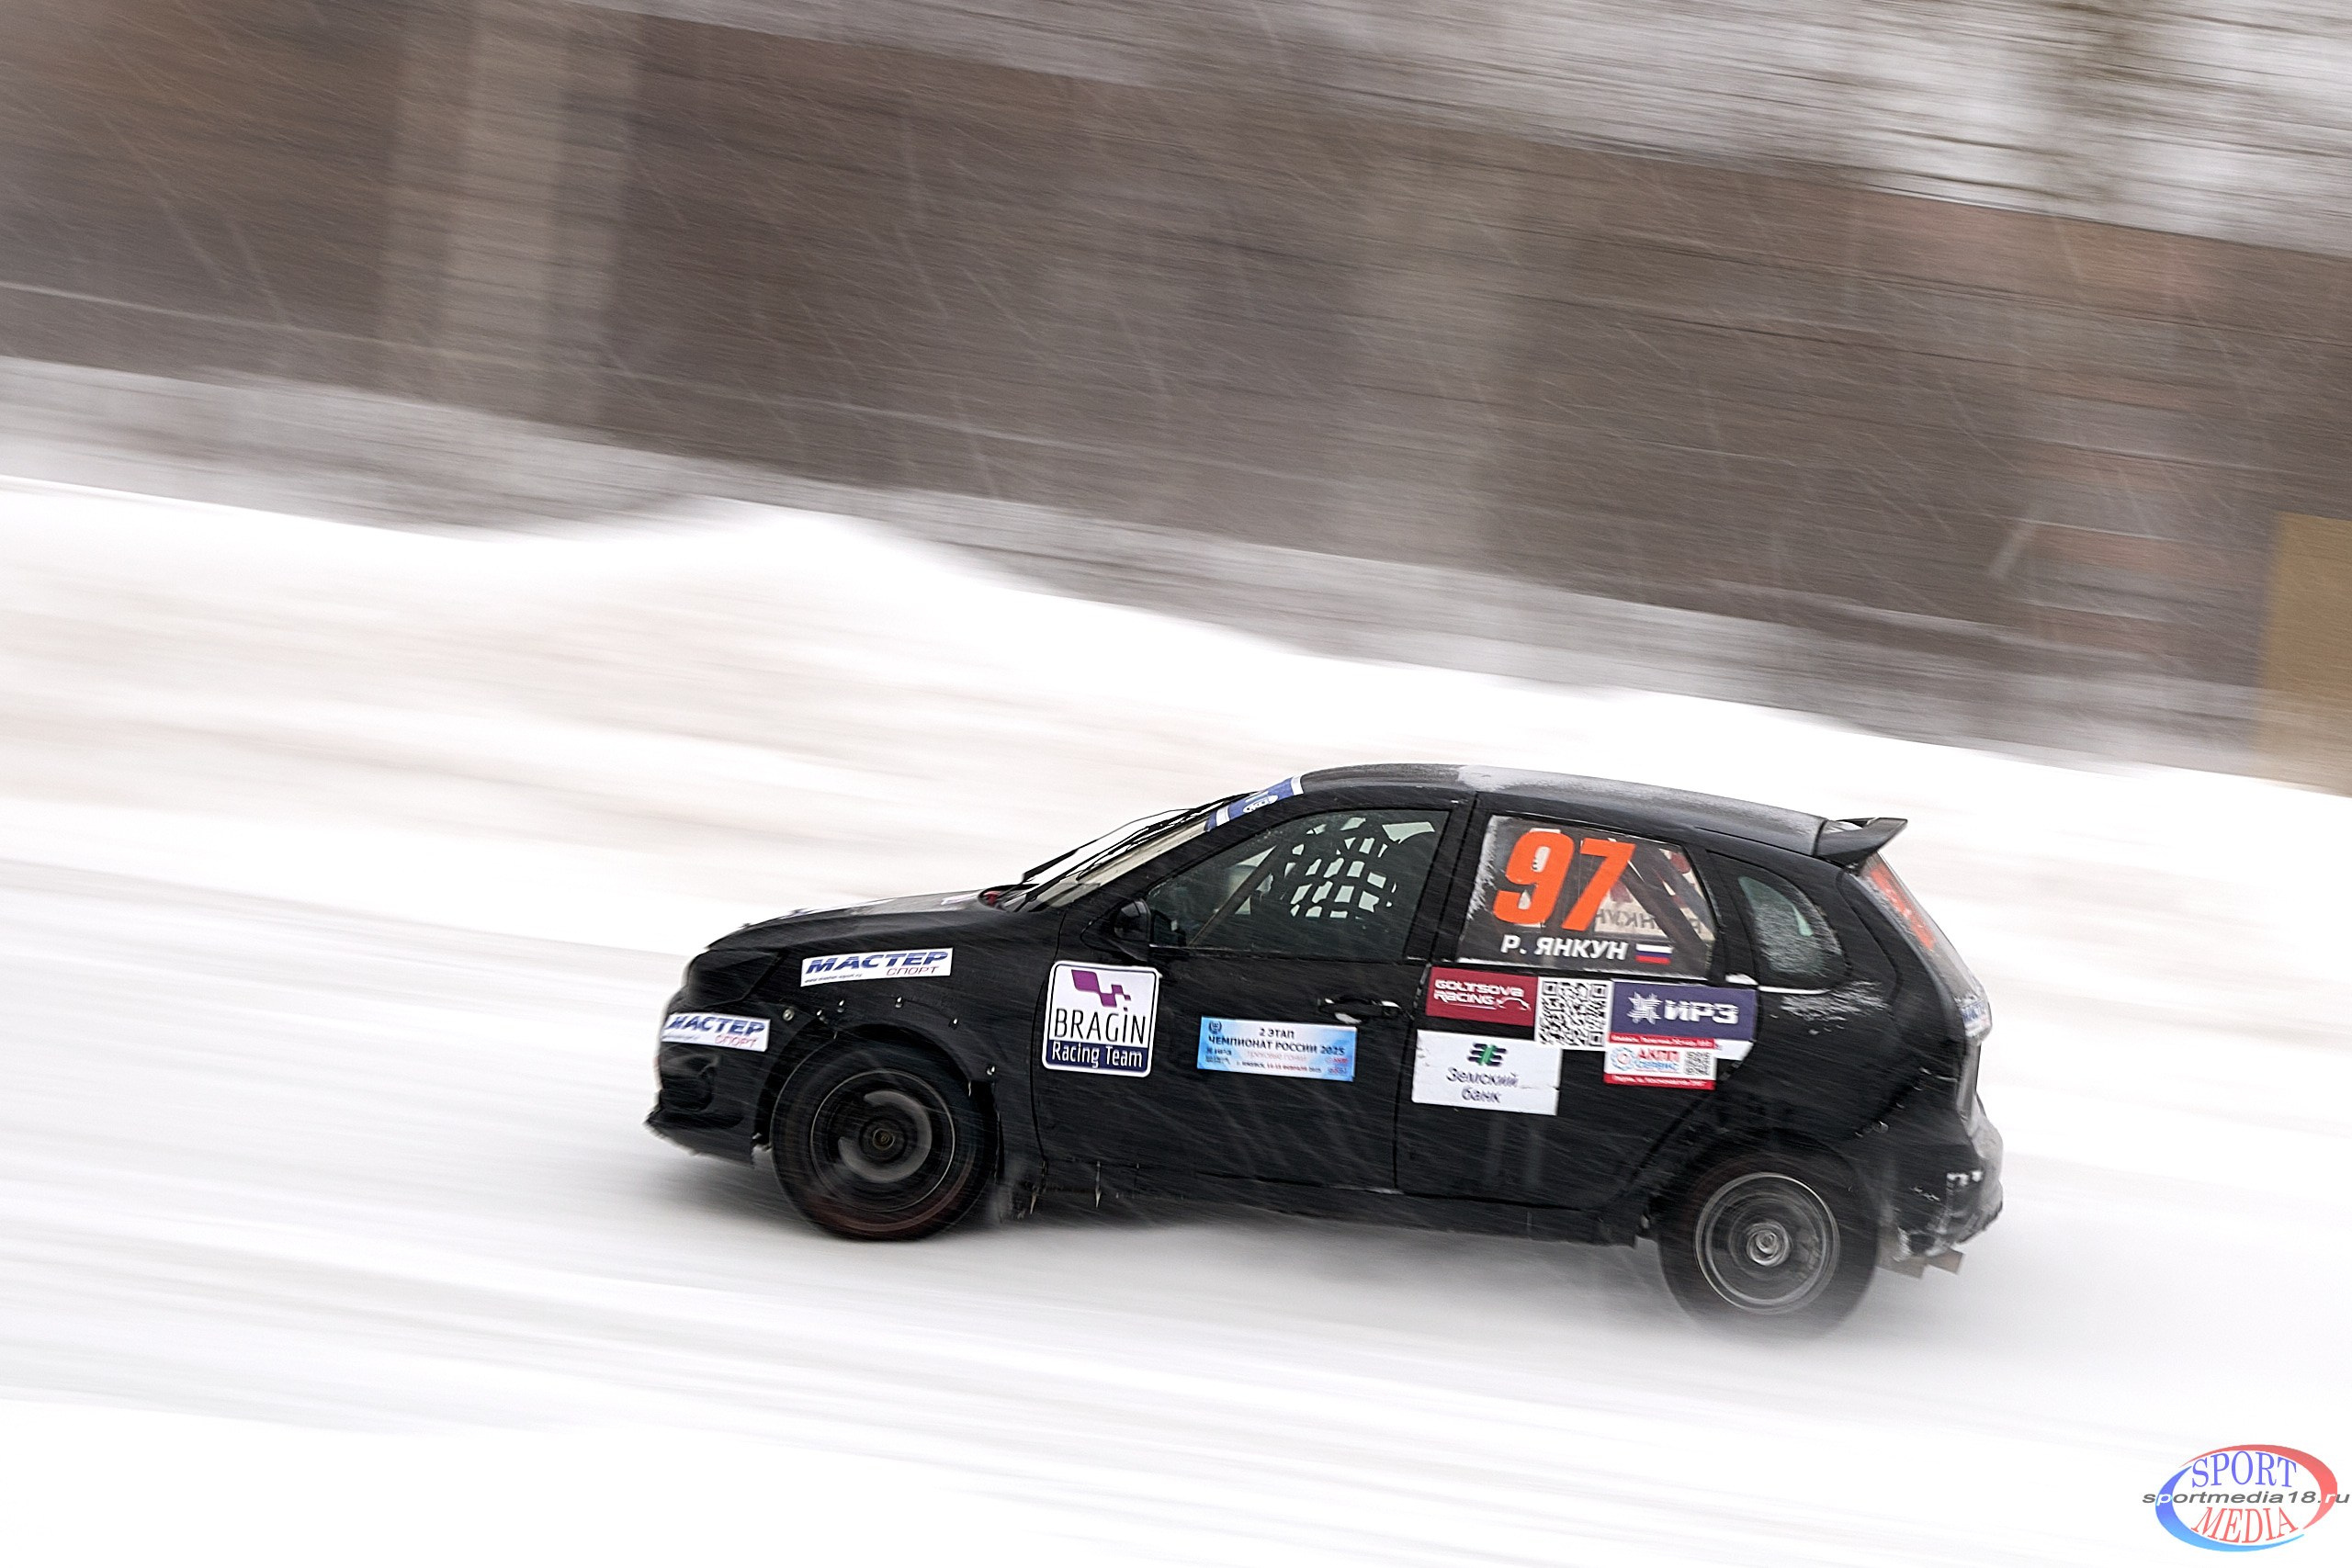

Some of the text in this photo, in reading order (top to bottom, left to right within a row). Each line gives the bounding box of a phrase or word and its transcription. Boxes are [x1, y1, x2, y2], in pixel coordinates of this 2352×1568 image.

[1492, 830, 1636, 931] 97
[1500, 933, 1629, 961] Р. ЯНКУН
[806, 951, 948, 974] МАСТЕР
[886, 965, 939, 976] СПОРТ
[1664, 998, 1739, 1024] ИРЗ
[1259, 1027, 1295, 1039] 2 ЭТАП
[1052, 1041, 1143, 1068] Racing Team
[1208, 1034, 1346, 1056] ЧЕМПИОНАТ РОССИИ 2025
[1446, 1066, 1520, 1088] Земский
[1461, 1086, 1502, 1103] банк
